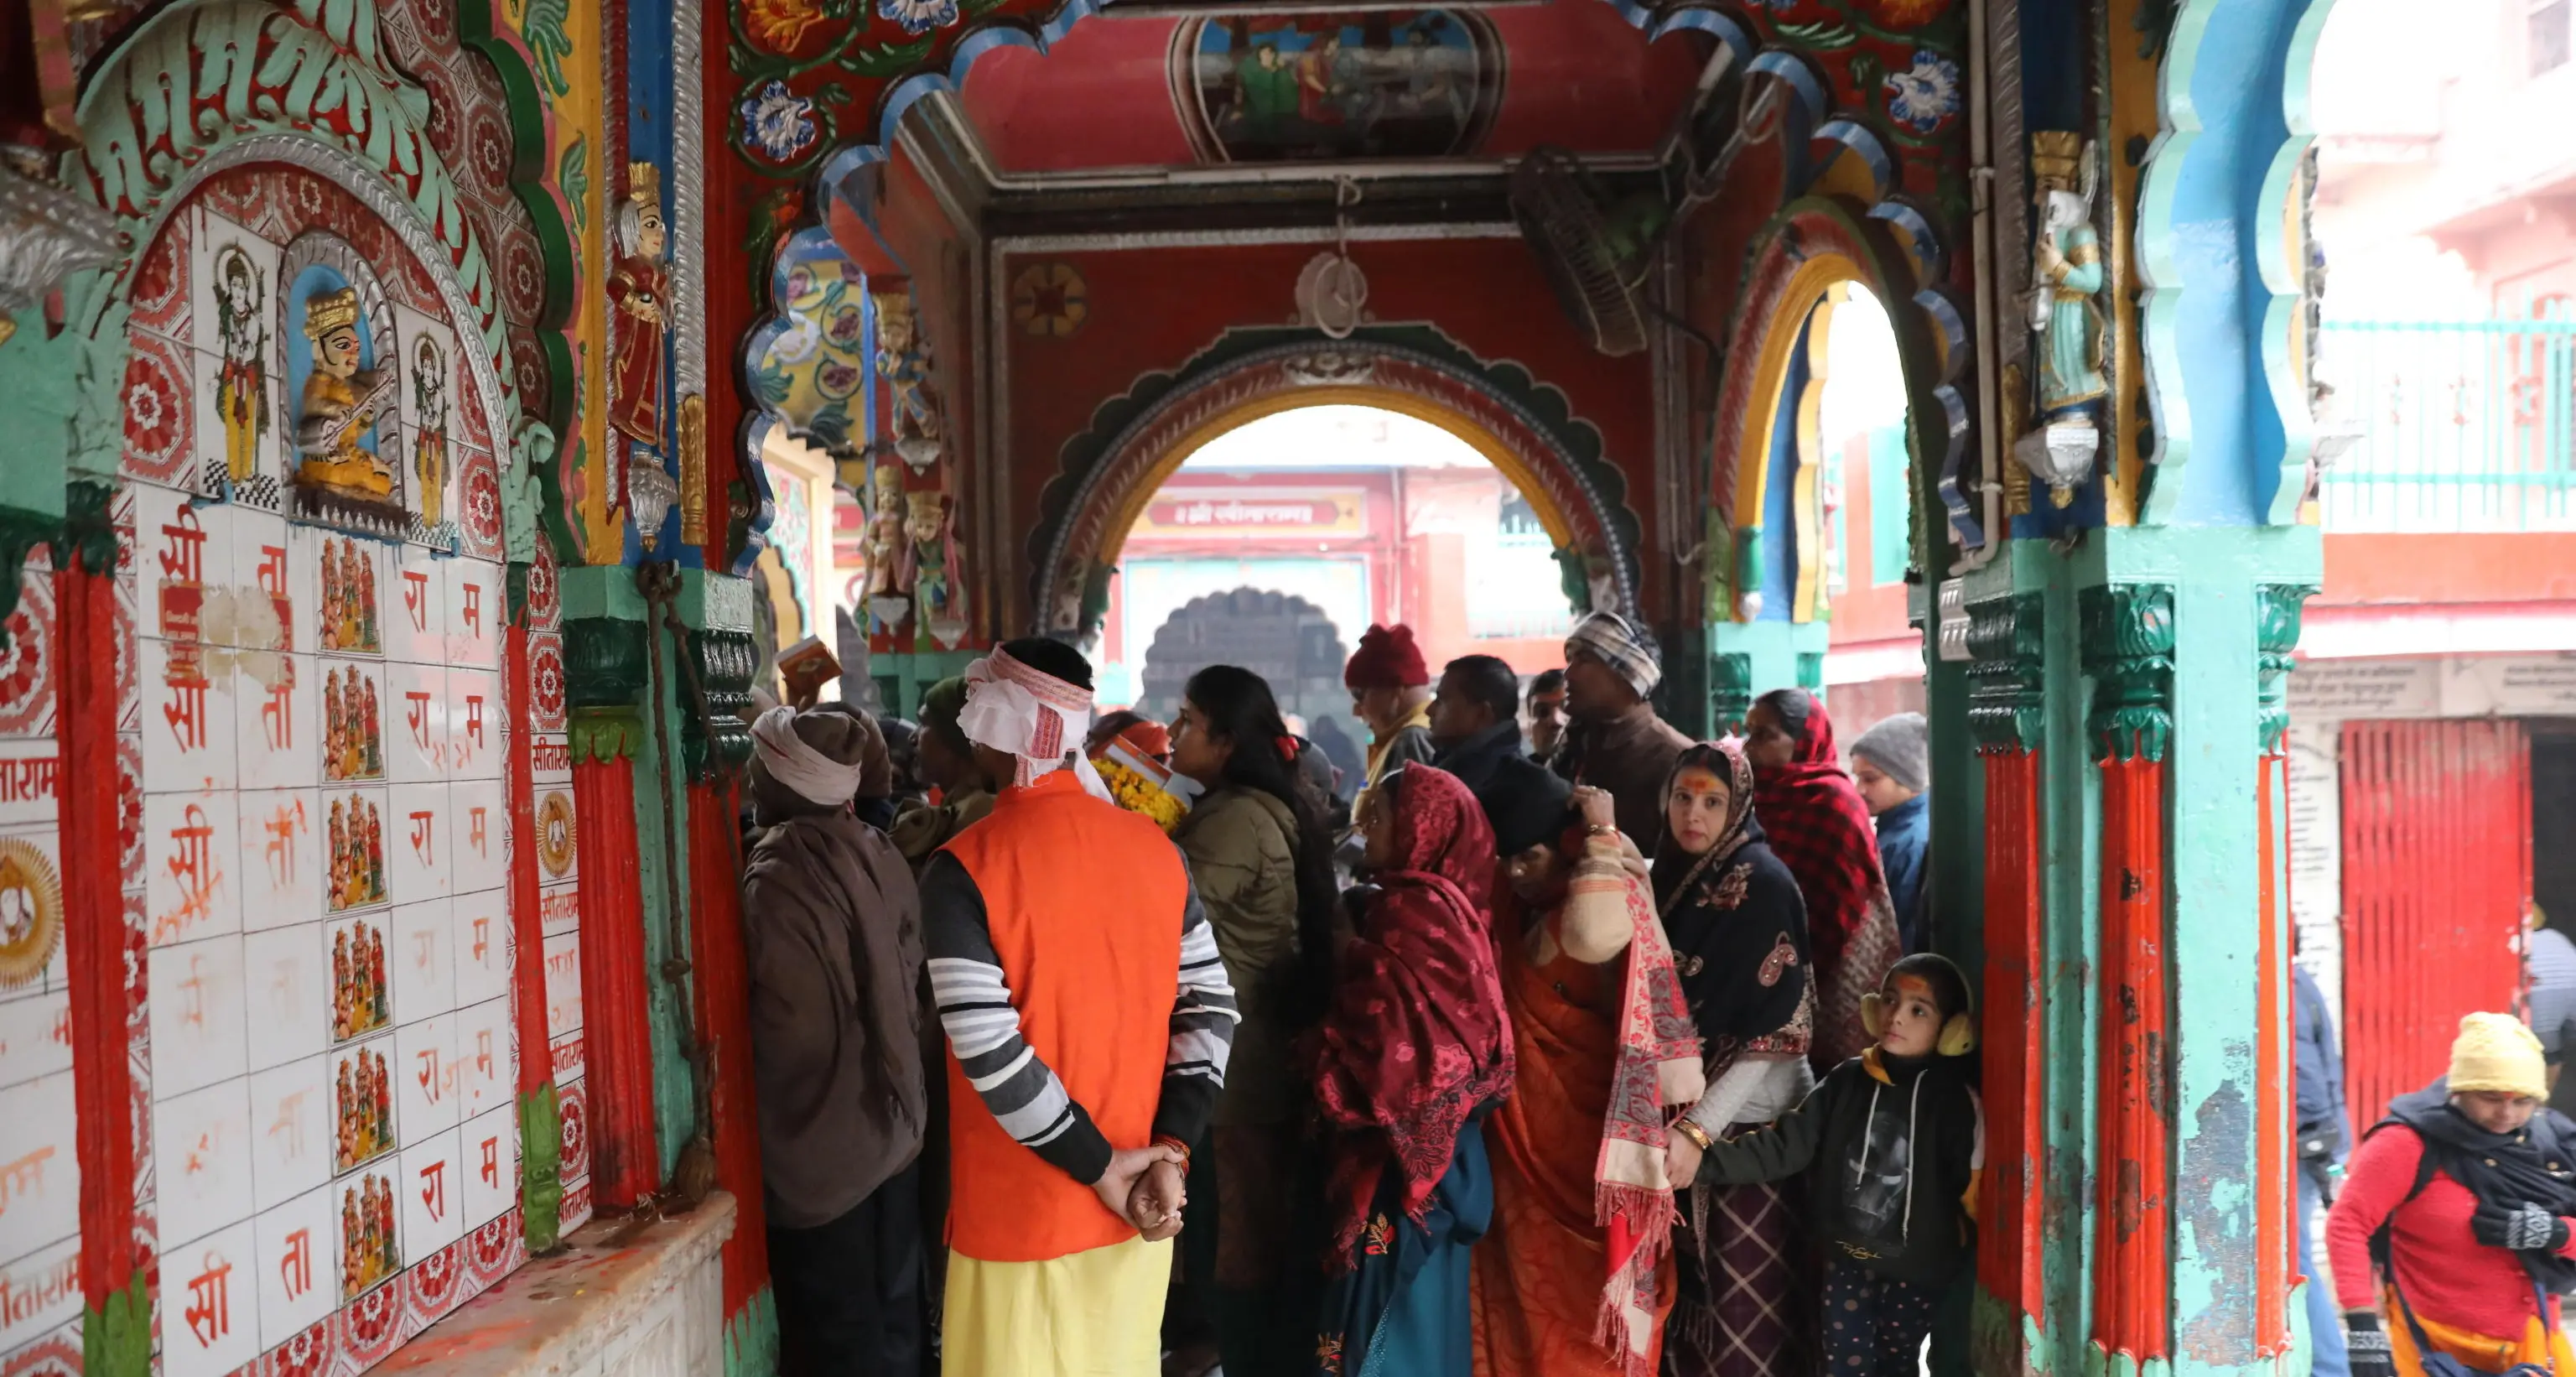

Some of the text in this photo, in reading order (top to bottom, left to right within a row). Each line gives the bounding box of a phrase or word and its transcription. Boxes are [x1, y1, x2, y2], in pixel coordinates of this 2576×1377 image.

[402, 570, 428, 633] रा
[463, 583, 480, 639] म
[406, 692, 430, 751] रा
[466, 695, 483, 749] म
[168, 803, 214, 902] सी
[409, 811, 434, 869] रा
[470, 807, 486, 860] म
[473, 917, 490, 969] म
[418, 1048, 439, 1104] रा
[476, 1029, 494, 1080] म
[185, 1136, 498, 1348] सी ता रा म
